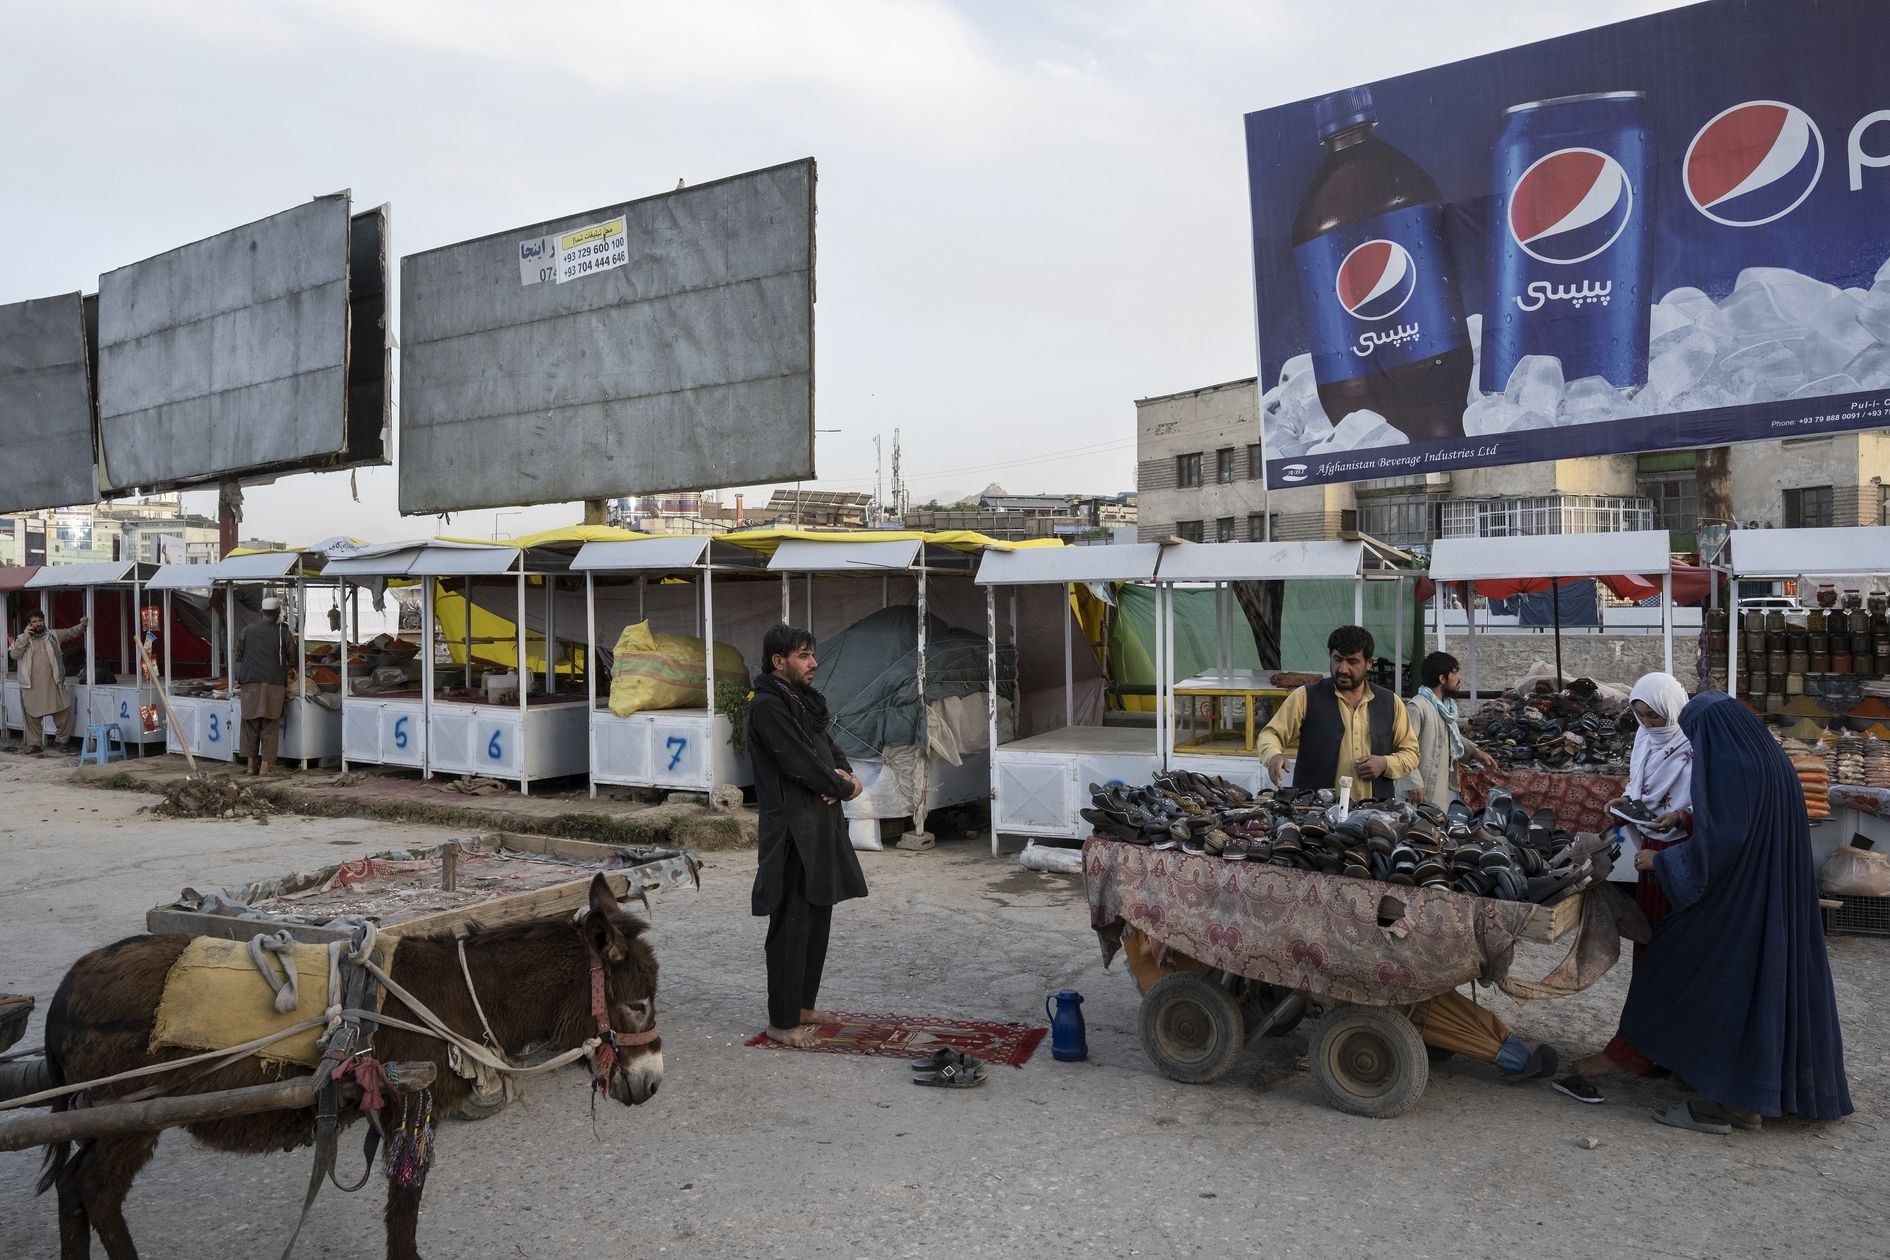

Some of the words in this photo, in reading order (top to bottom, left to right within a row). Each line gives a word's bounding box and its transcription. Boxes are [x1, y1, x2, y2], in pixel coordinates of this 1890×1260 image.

[563, 252, 576, 263] +93
[578, 246, 591, 259] 729
[593, 242, 609, 254] 600
[611, 237, 625, 250] 100
[564, 266, 576, 277] +93
[578, 261, 593, 274] 704
[594, 256, 610, 269] 444
[612, 251, 625, 264] 646
[1516, 280, 1612, 312] پیپسی
[1353, 322, 1419, 357] پیپسی
[1826, 414, 1840, 422] 888
[1842, 412, 1860, 420] 0091
[1867, 409, 1882, 417] +93
[1316, 460, 1375, 476] Afghanistan
[1377, 454, 1421, 468] Beverage
[1424, 448, 1475, 462] Industries
[1477, 443, 1499, 457] Ltd
[119, 701, 130, 719] 2
[208, 713, 220, 742] 3
[395, 716, 408, 748] 5
[488, 729, 502, 759] 6
[666, 736, 687, 771] 7
